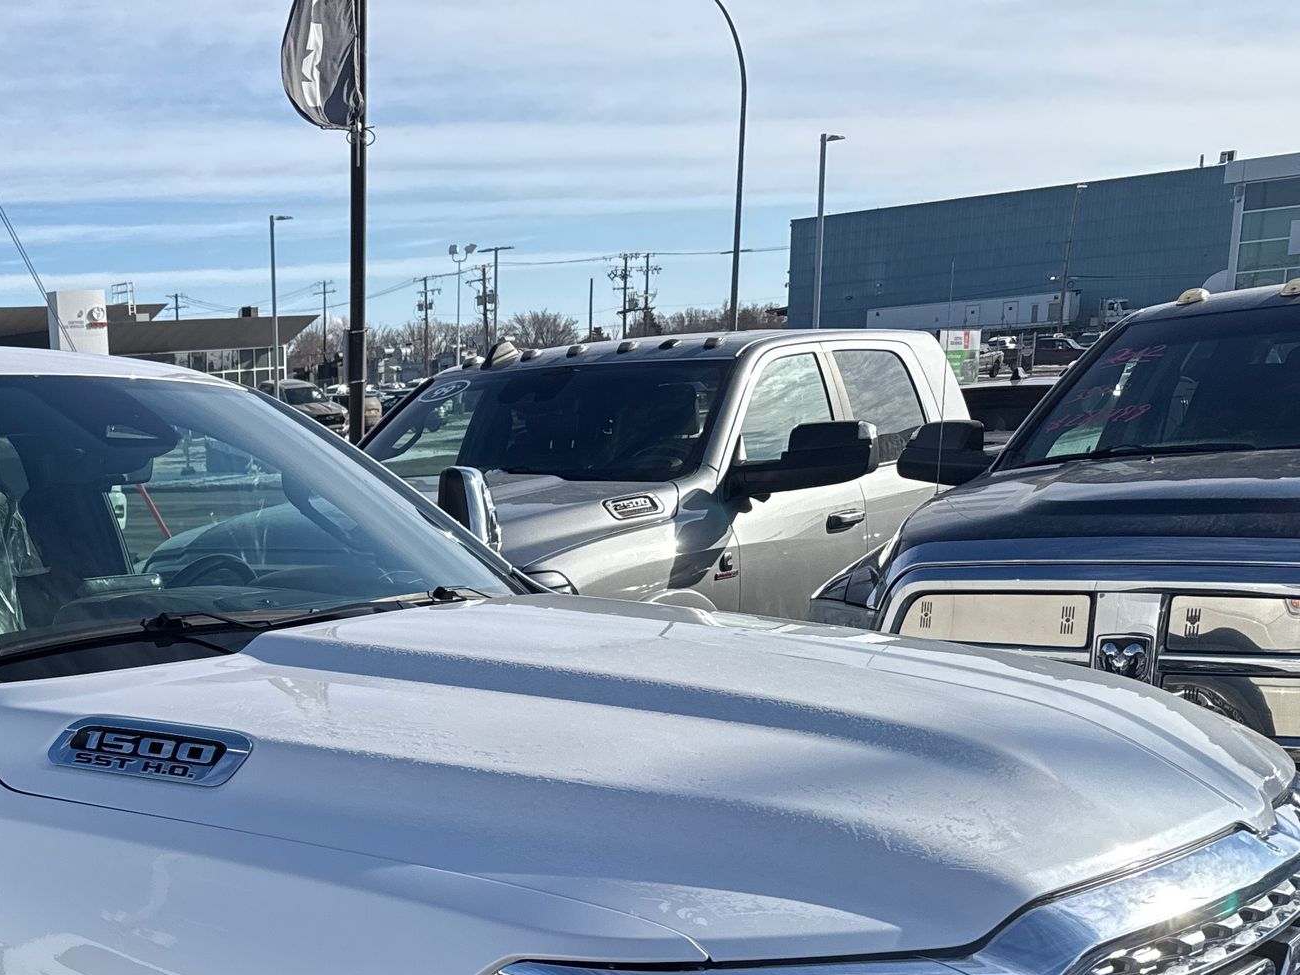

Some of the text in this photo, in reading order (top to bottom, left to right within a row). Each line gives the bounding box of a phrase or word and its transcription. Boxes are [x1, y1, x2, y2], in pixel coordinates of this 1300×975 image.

[86, 730, 217, 764] 1500
[73, 752, 196, 780] SST H.O.
